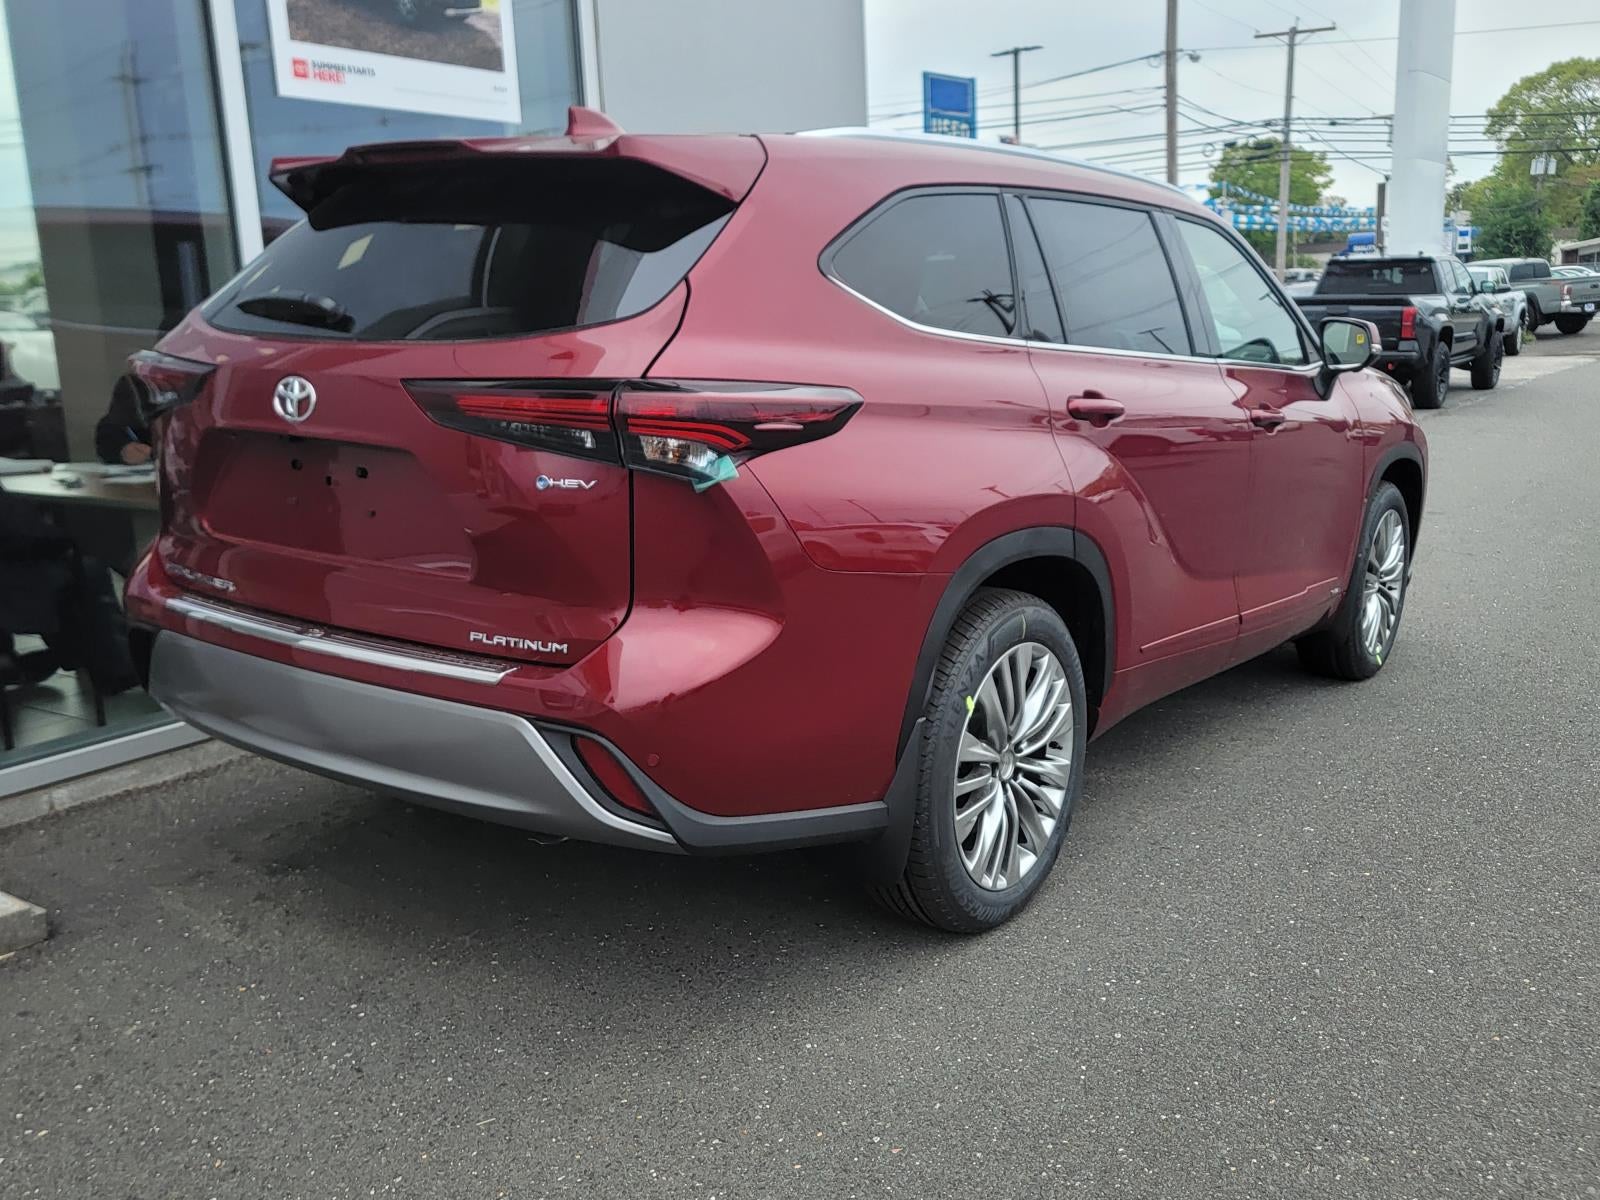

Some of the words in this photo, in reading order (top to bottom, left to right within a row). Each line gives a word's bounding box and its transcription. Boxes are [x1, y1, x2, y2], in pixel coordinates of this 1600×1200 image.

[311, 60, 347, 72] SUMMER
[347, 64, 376, 77] STARTS
[313, 70, 346, 84] HERE!
[549, 477, 598, 489] HEV
[469, 631, 568, 654] PLATINUM
